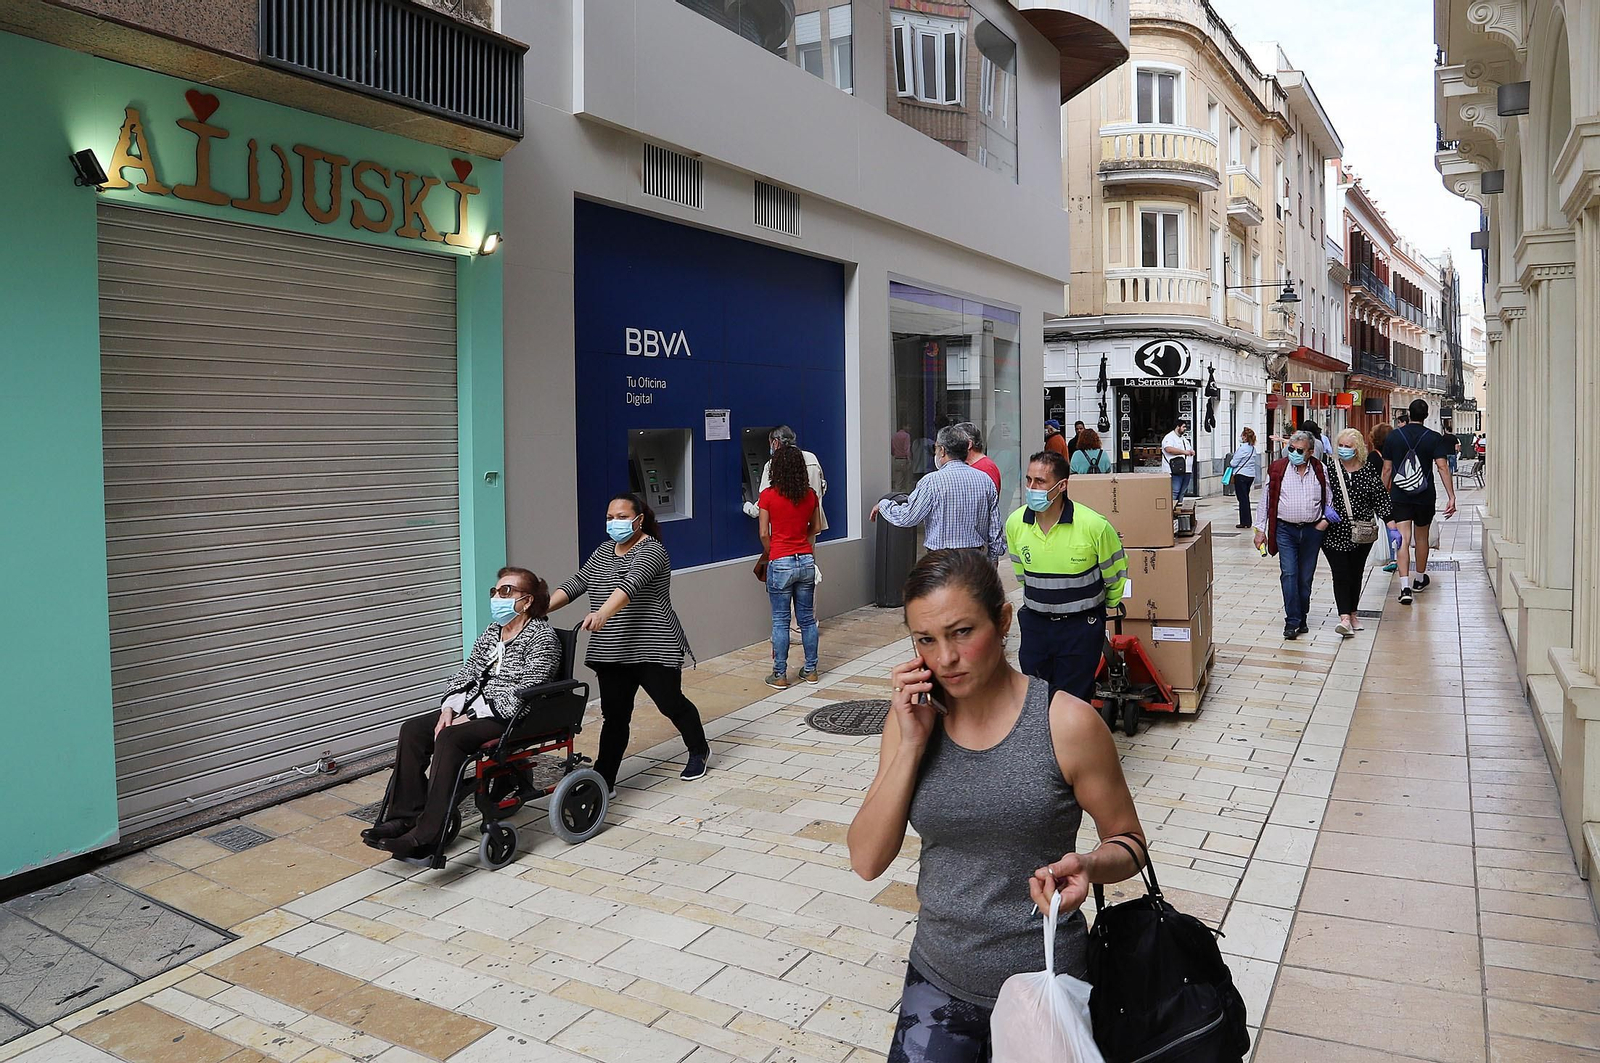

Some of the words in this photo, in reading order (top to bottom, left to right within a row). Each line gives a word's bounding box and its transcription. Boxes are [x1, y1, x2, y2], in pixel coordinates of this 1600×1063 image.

[625, 327, 691, 358] BBVA
[626, 375, 637, 388] Tu
[638, 376, 667, 389] Oficina
[1124, 378, 1135, 386] La
[1138, 377, 1175, 387] Serranía
[626, 392, 653, 406] Digital
